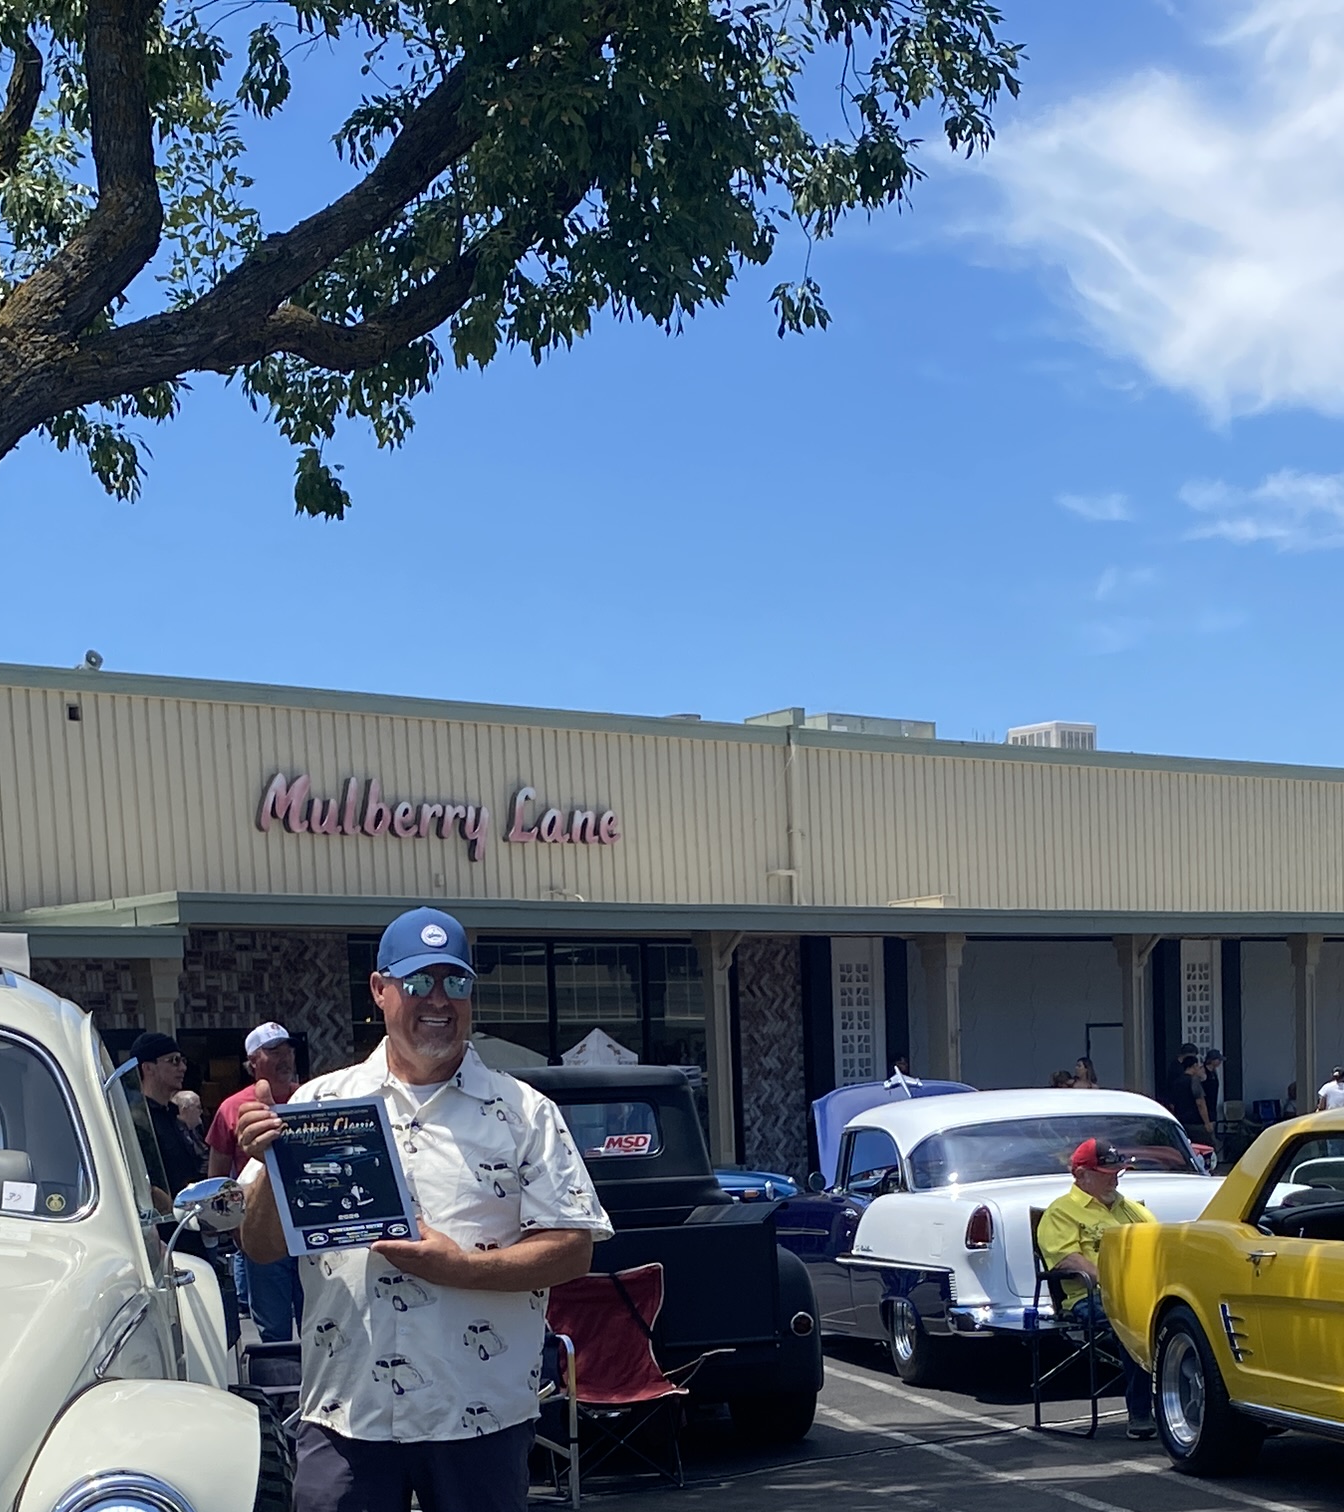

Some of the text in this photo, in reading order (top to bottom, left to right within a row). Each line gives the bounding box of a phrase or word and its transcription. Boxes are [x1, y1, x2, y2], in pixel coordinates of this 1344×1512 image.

[256, 772, 621, 862] Mulberry Lane
[606, 1136, 648, 1149] MSD
